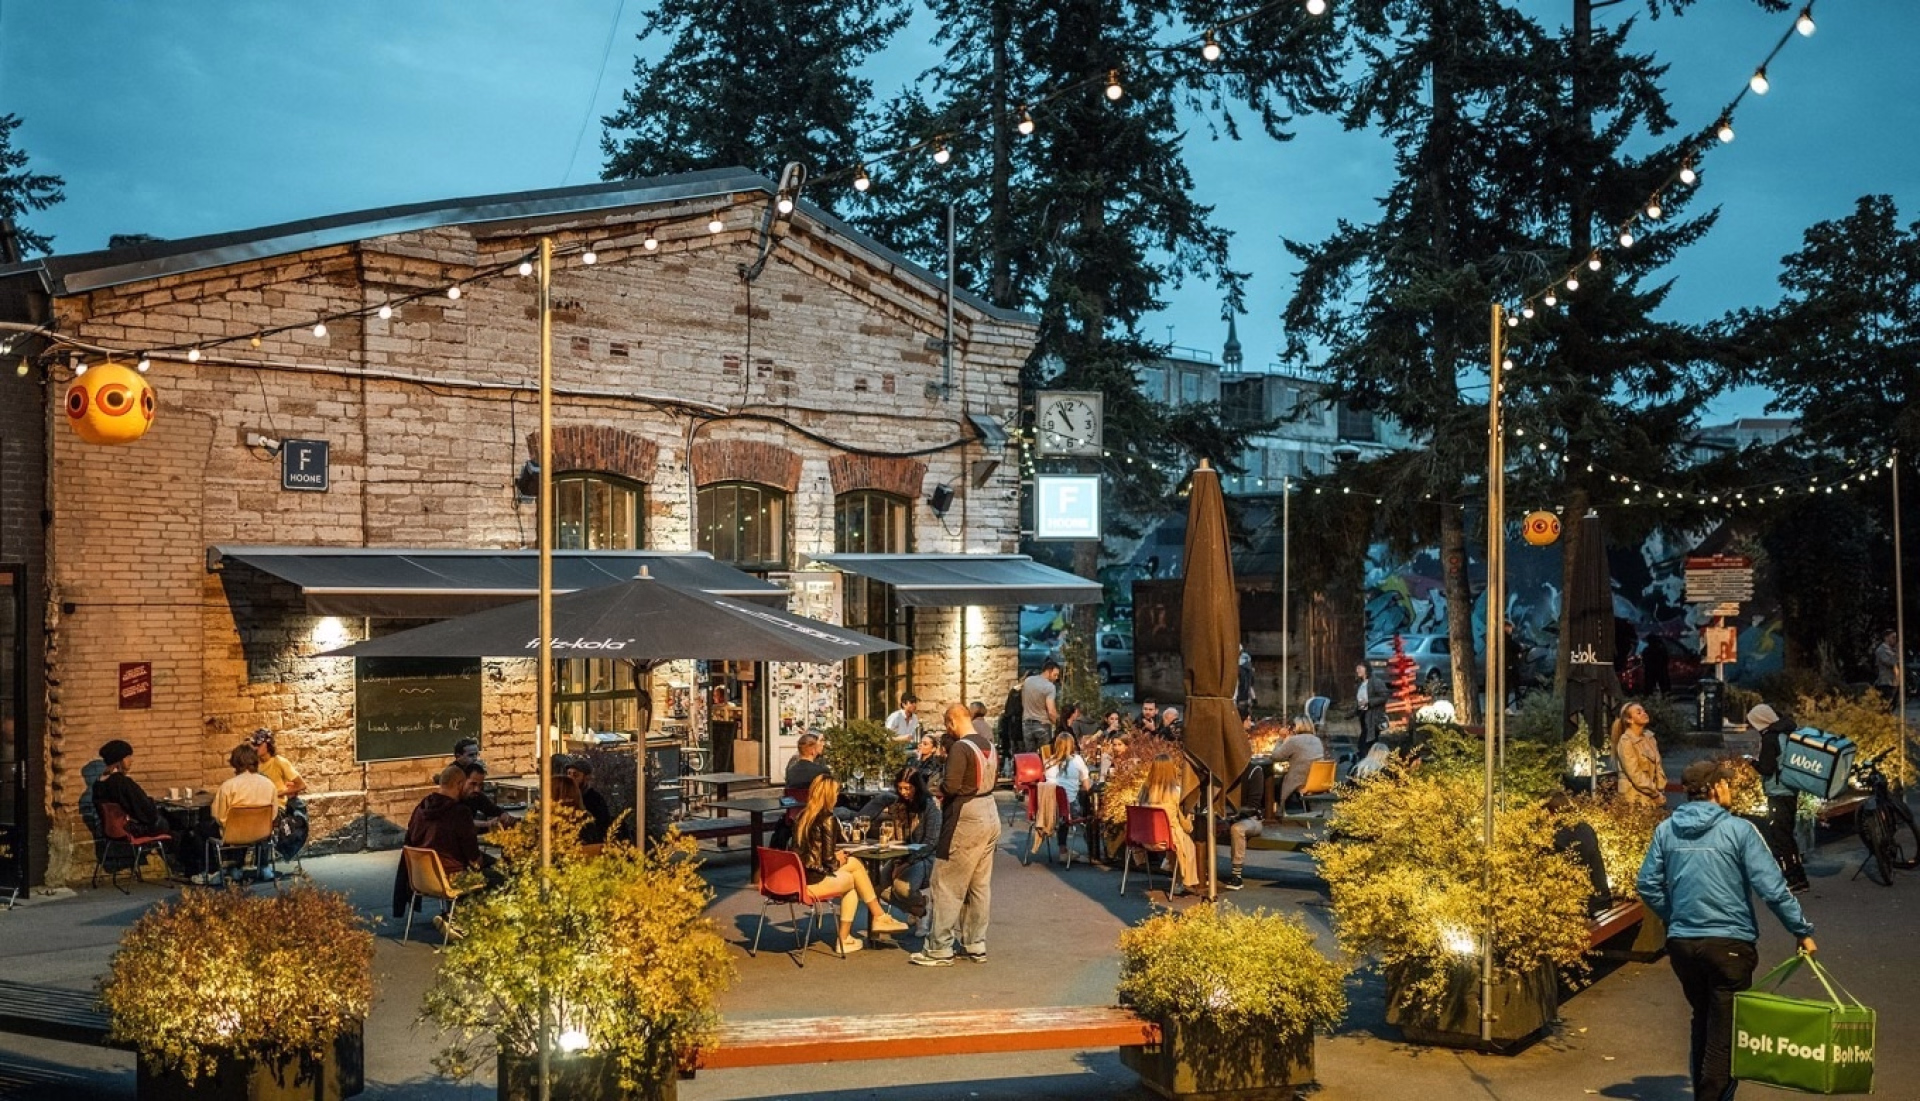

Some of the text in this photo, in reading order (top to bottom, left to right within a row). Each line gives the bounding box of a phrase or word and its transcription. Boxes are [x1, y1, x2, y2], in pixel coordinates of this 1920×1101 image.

[1048, 420, 1055, 430] 9
[1084, 420, 1092, 430] 3
[1067, 438, 1074, 448] 6
[300, 448, 312, 471] F
[290, 473, 322, 484] HOONE
[1059, 486, 1079, 513] F
[525, 637, 627, 650] frtz-kola
[1789, 753, 1824, 774] Wolt
[1737, 1030, 1826, 1062] Bolt Food
[1833, 1045, 1854, 1065] Bolt
